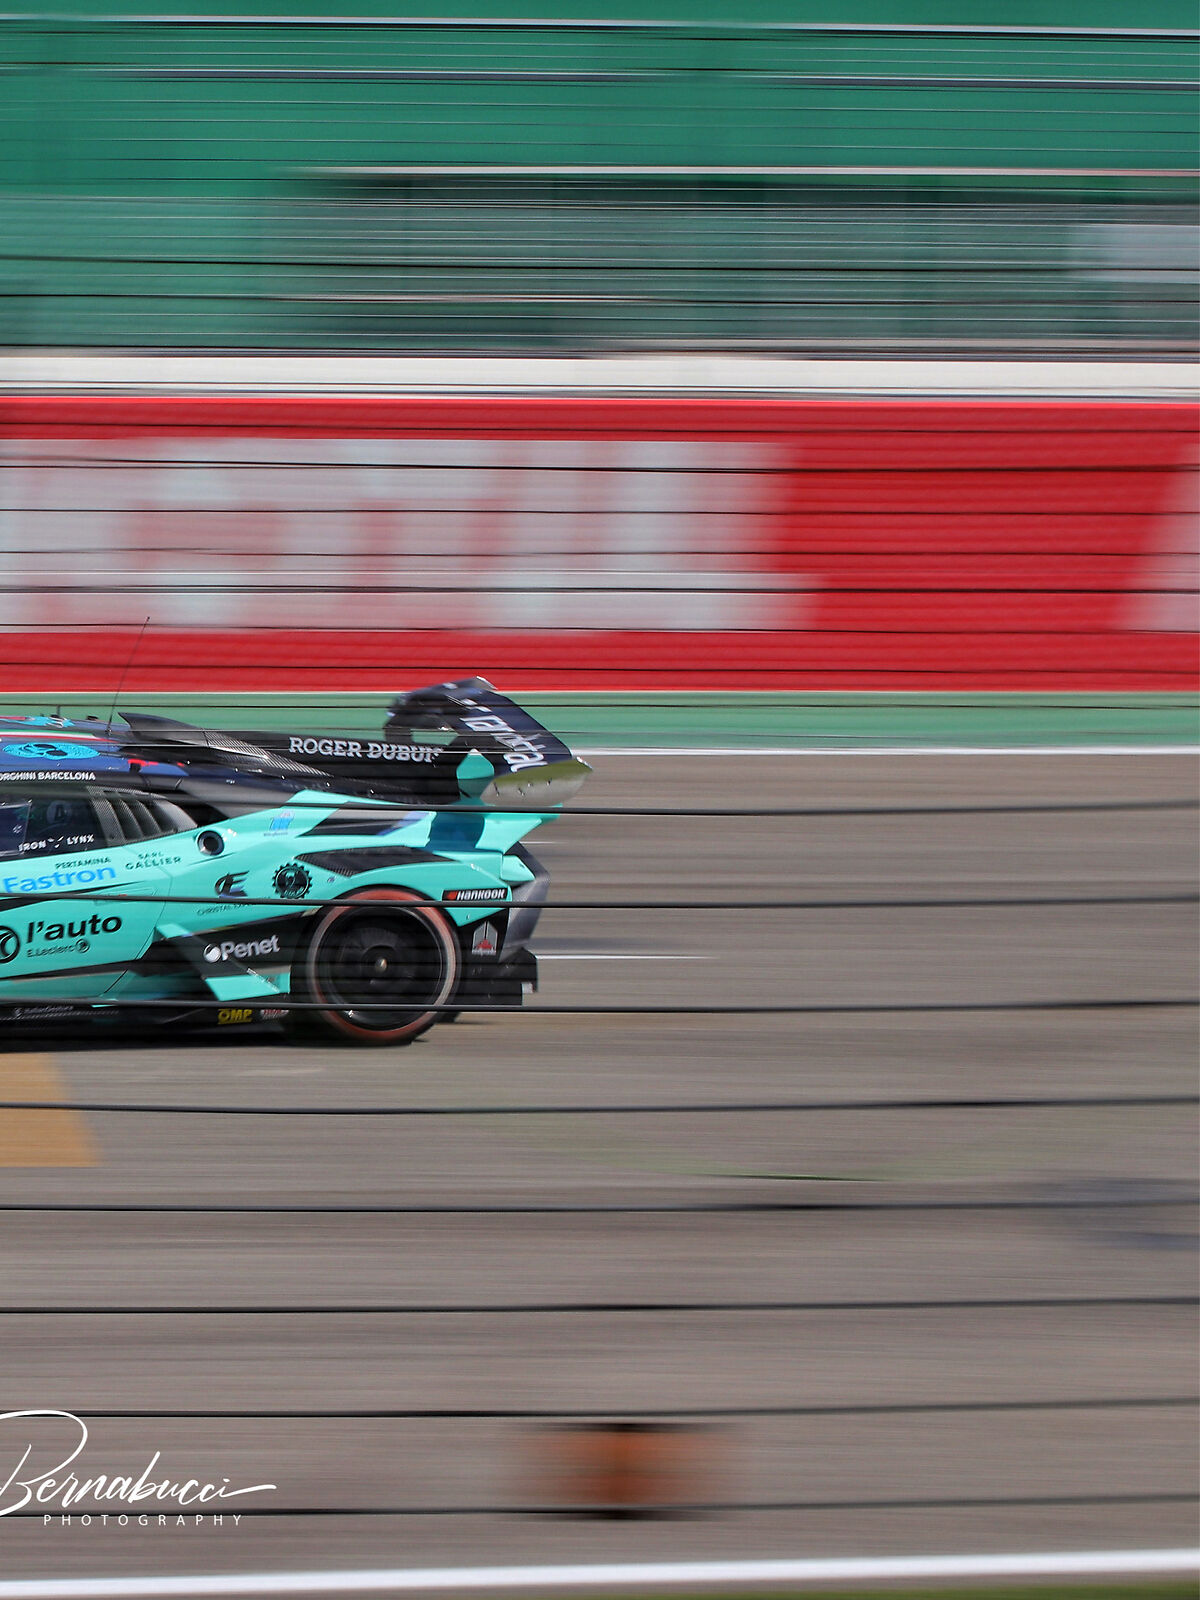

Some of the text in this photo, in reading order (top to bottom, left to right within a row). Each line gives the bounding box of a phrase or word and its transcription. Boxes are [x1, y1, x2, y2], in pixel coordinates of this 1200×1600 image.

[289, 736, 363, 758] ROGER
[37, 771, 96, 782] BARCELONA
[18, 834, 95, 852] IRON LYNX
[3, 866, 116, 893] Fastron
[26, 914, 123, 944] l'auto
[220, 934, 281, 961] Penet
[217, 1008, 253, 1021] OMP
